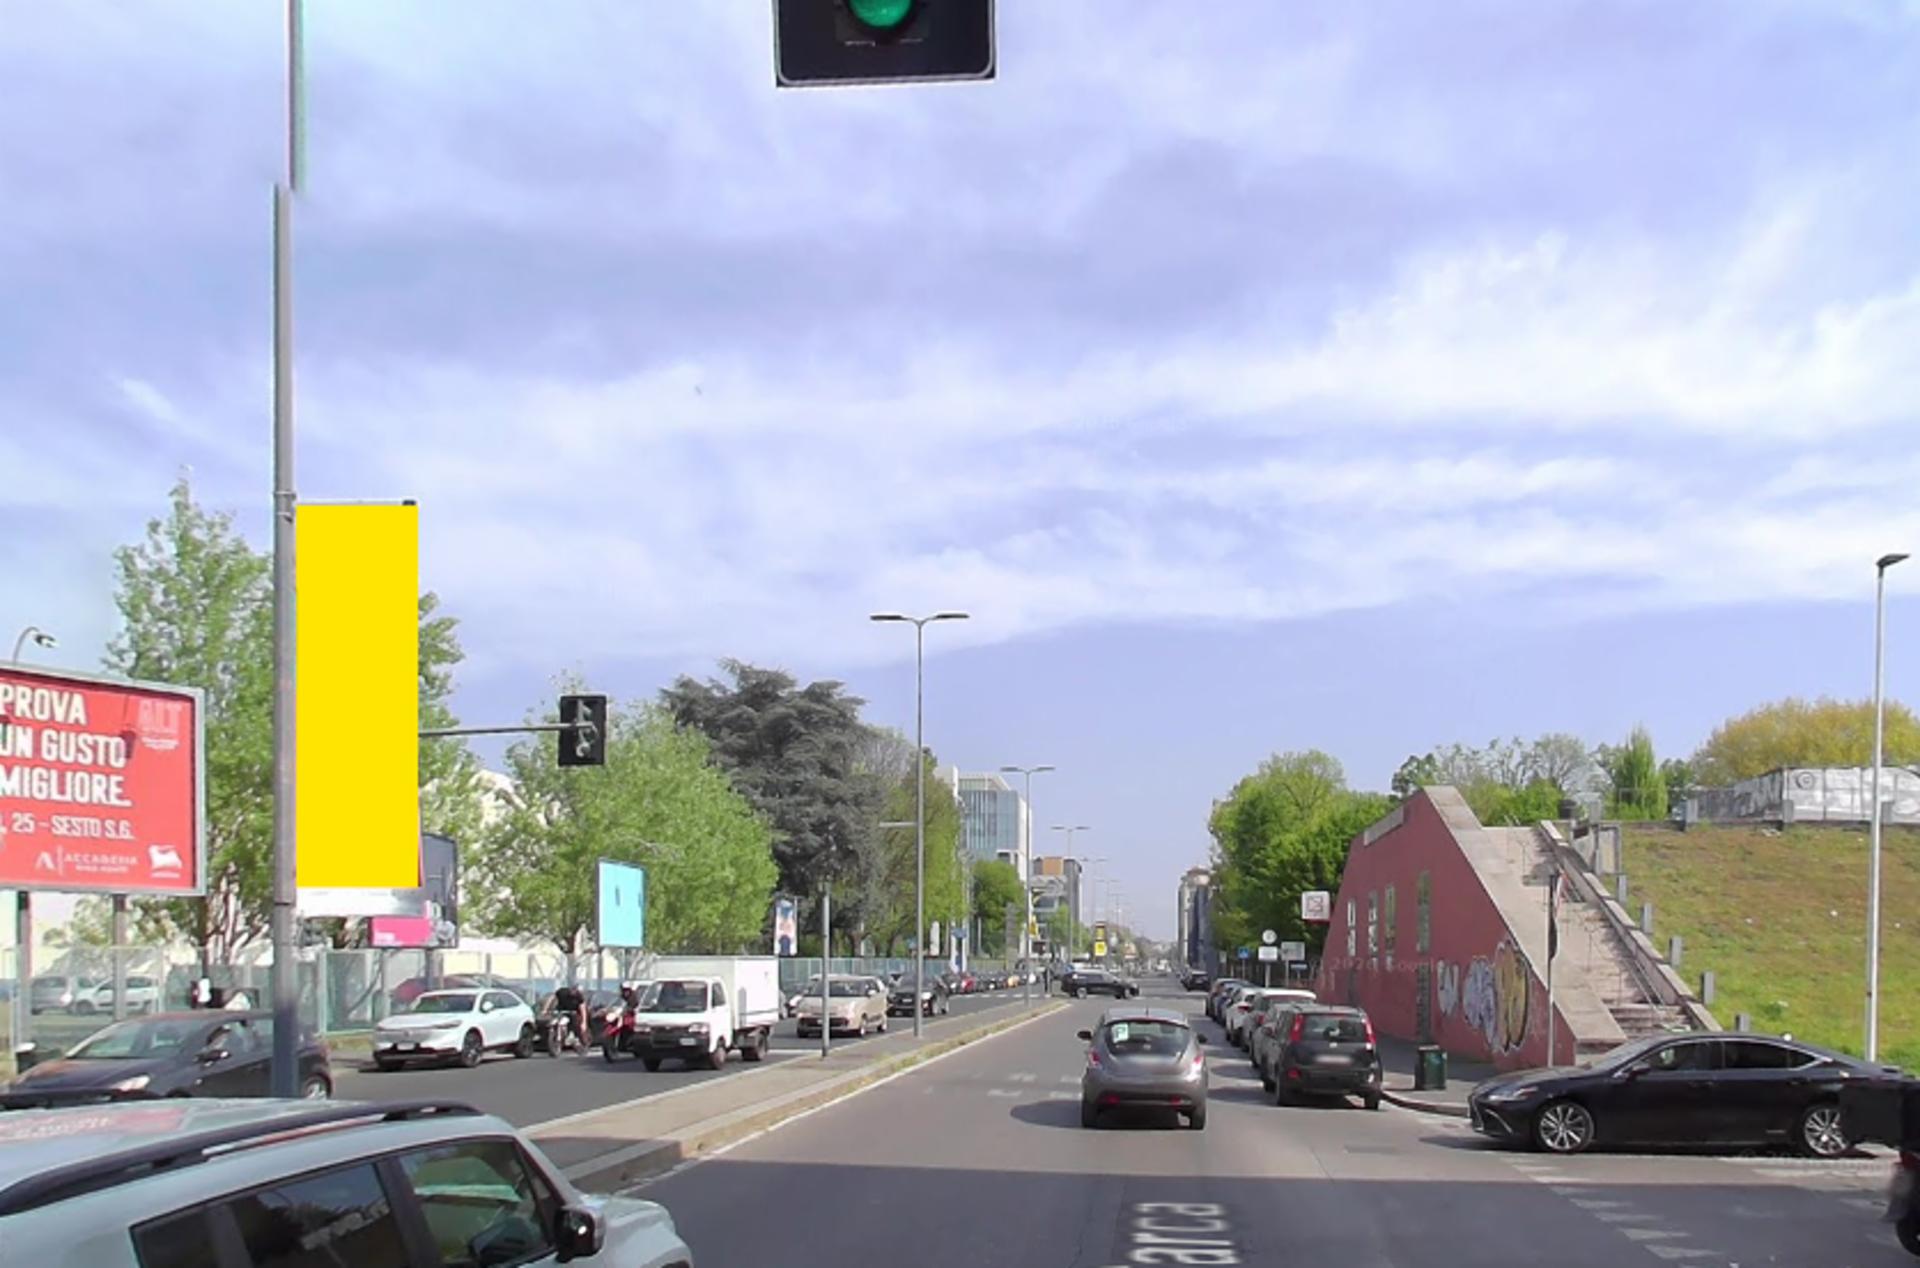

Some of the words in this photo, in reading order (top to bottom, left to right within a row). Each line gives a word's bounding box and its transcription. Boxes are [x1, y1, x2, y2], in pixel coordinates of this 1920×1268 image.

[0, 683, 87, 726] PROVA
[0, 723, 33, 759] UN
[41, 729, 127, 768] GUSTO
[11, 812, 35, 833] 25
[51, 815, 101, 838] SESTO
